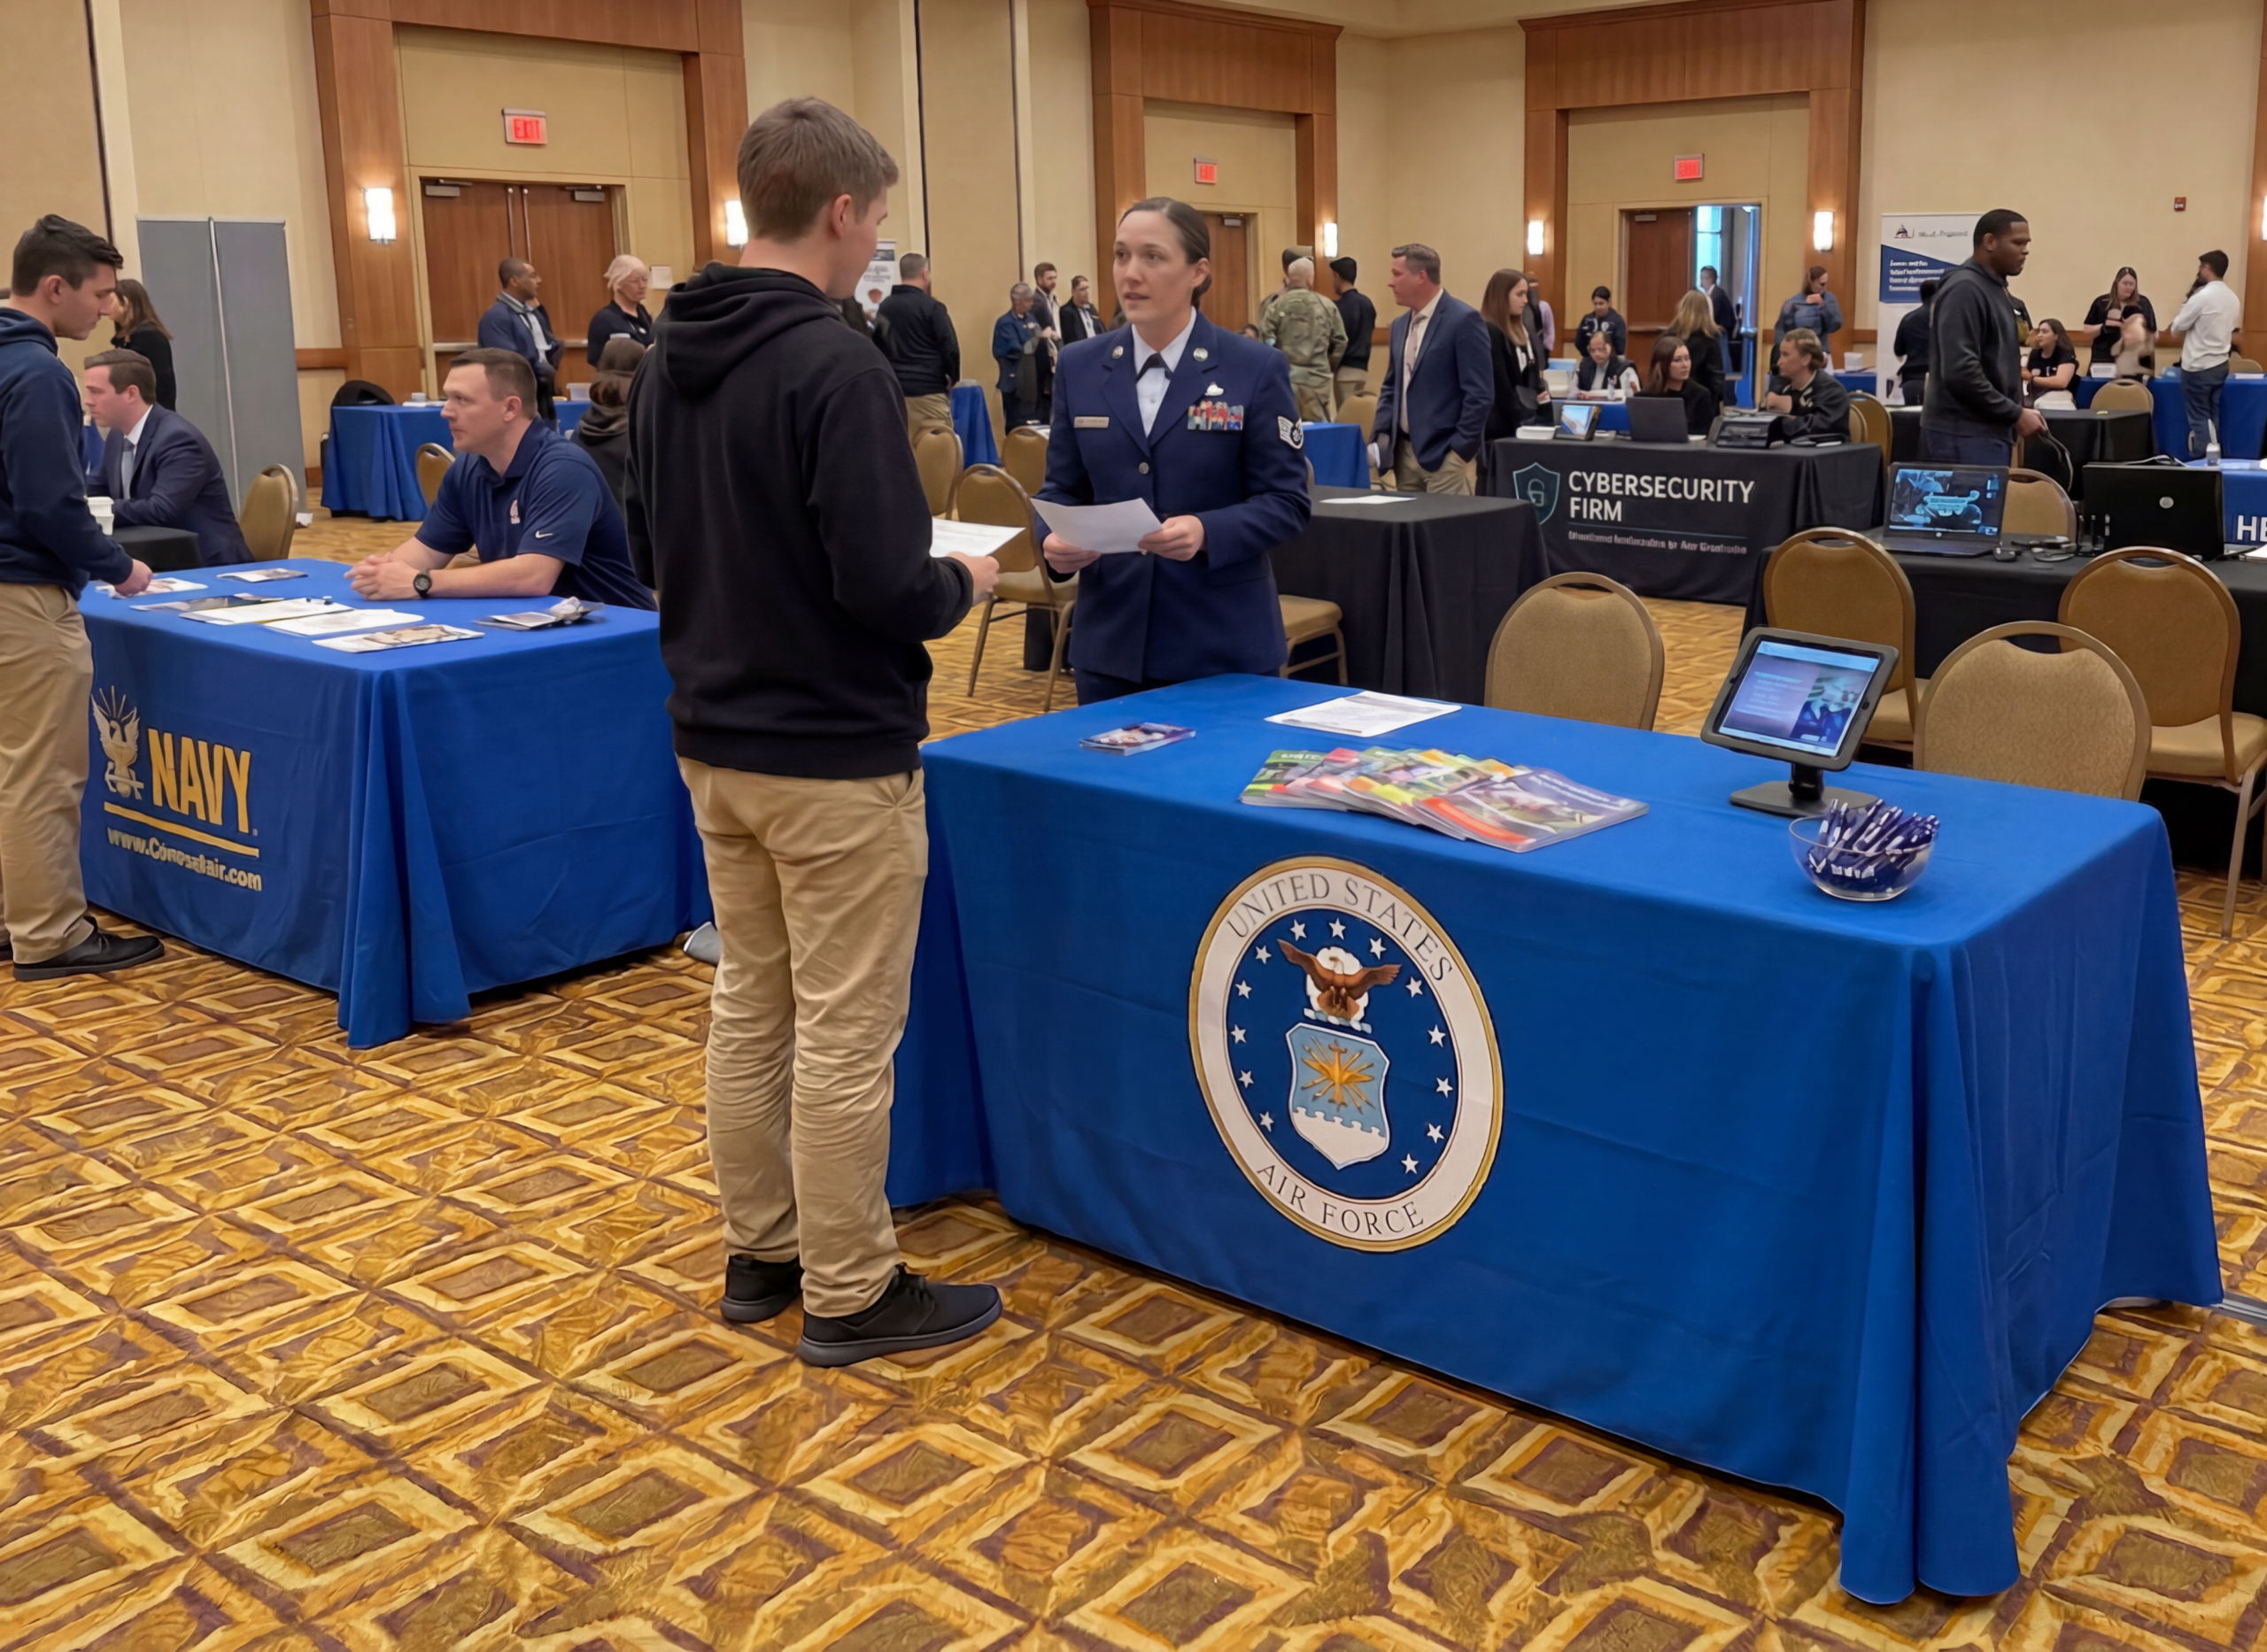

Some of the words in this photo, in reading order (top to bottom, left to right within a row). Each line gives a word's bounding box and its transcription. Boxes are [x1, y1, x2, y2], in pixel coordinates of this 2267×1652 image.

[1568, 470, 1755, 504] CYBERSECURITY
[1569, 497, 1622, 522] FIRM
[147, 727, 251, 834] NAVY
[1225, 873, 1331, 938] UNITED
[1343, 876, 1454, 982] STATES
[1256, 1164, 1307, 1214] AIR
[1320, 1200, 1425, 1236] FORCE
